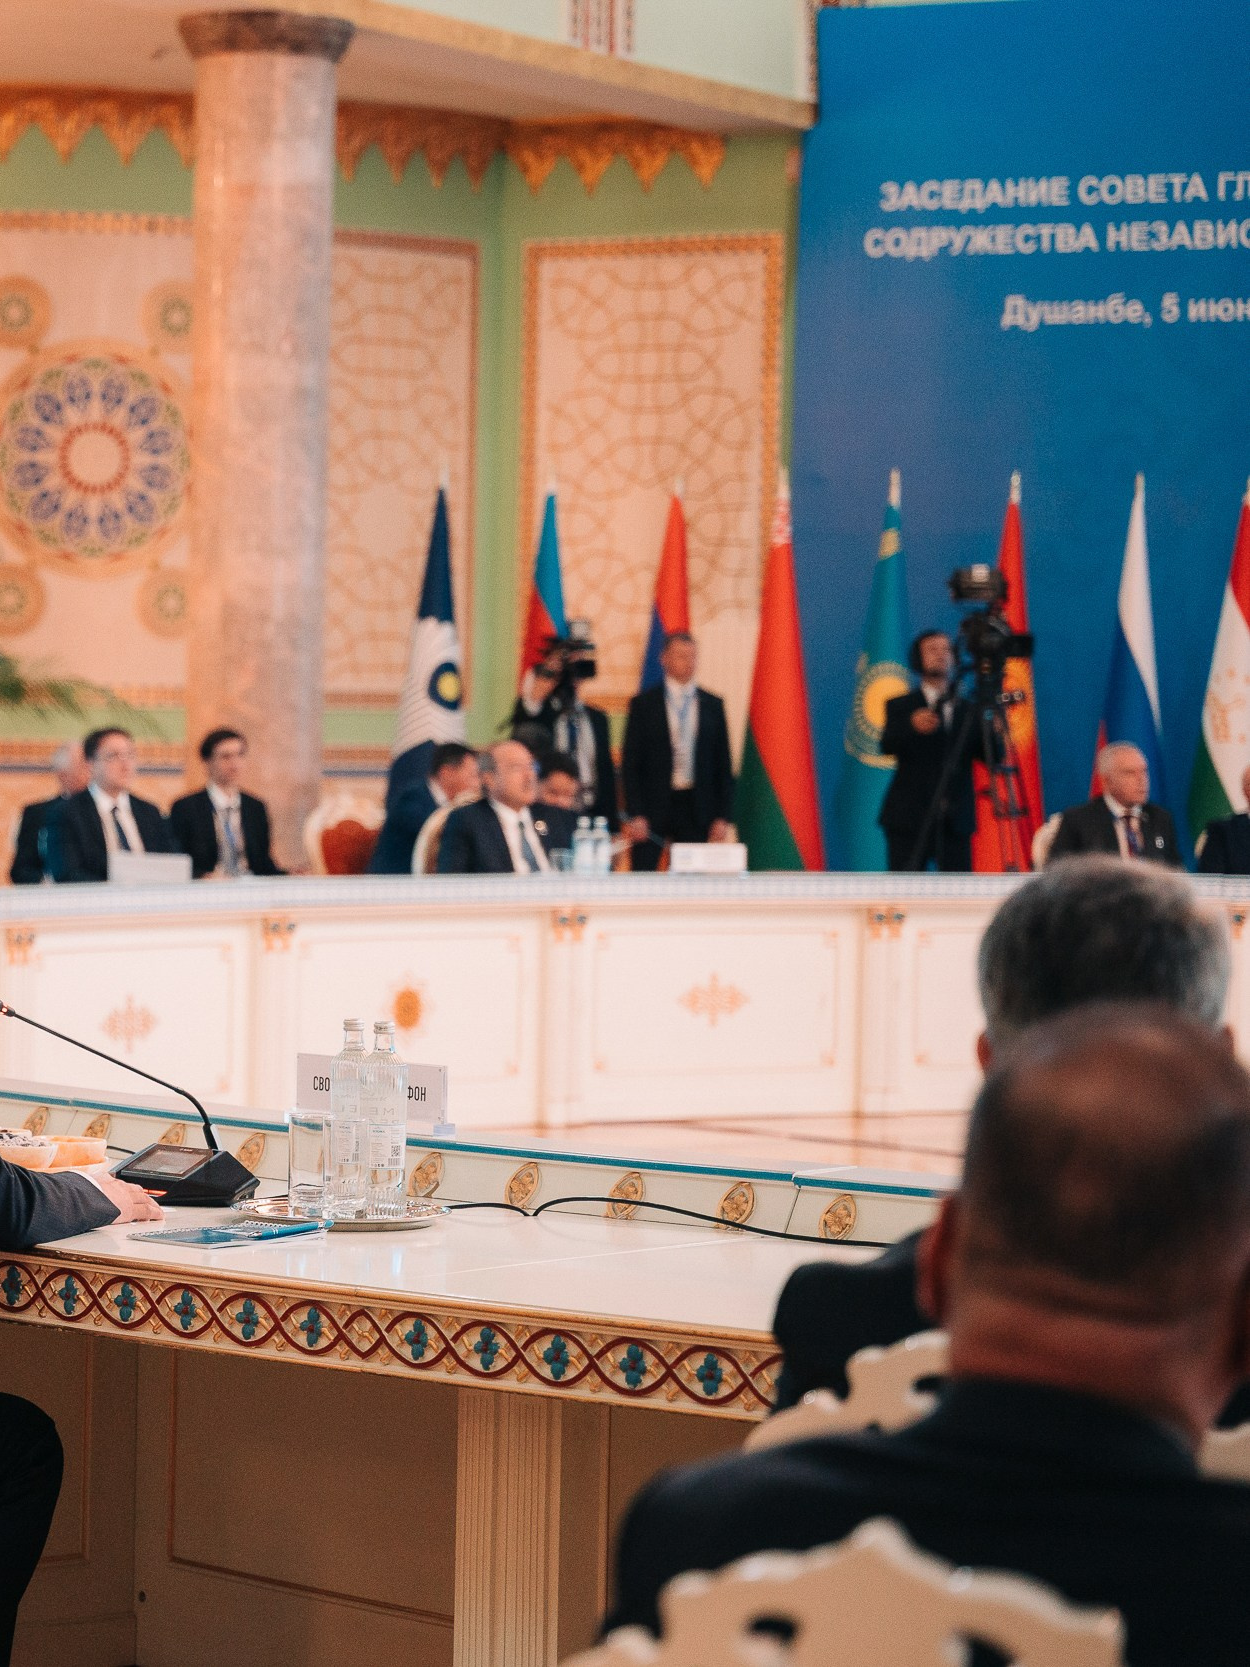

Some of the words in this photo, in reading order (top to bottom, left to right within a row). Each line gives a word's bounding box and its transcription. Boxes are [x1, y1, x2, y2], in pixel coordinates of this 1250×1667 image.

[880, 175, 1071, 213] ЗАСЕДАНИЕ
[1076, 172, 1210, 206] СОВЕТА
[863, 223, 1100, 262] СОДРУЖЕСТВА
[1000, 292, 1153, 333] Душанбе,
[1160, 292, 1181, 324] 5
[313, 1075, 331, 1092] СВО
[407, 1085, 427, 1102] ФОН
